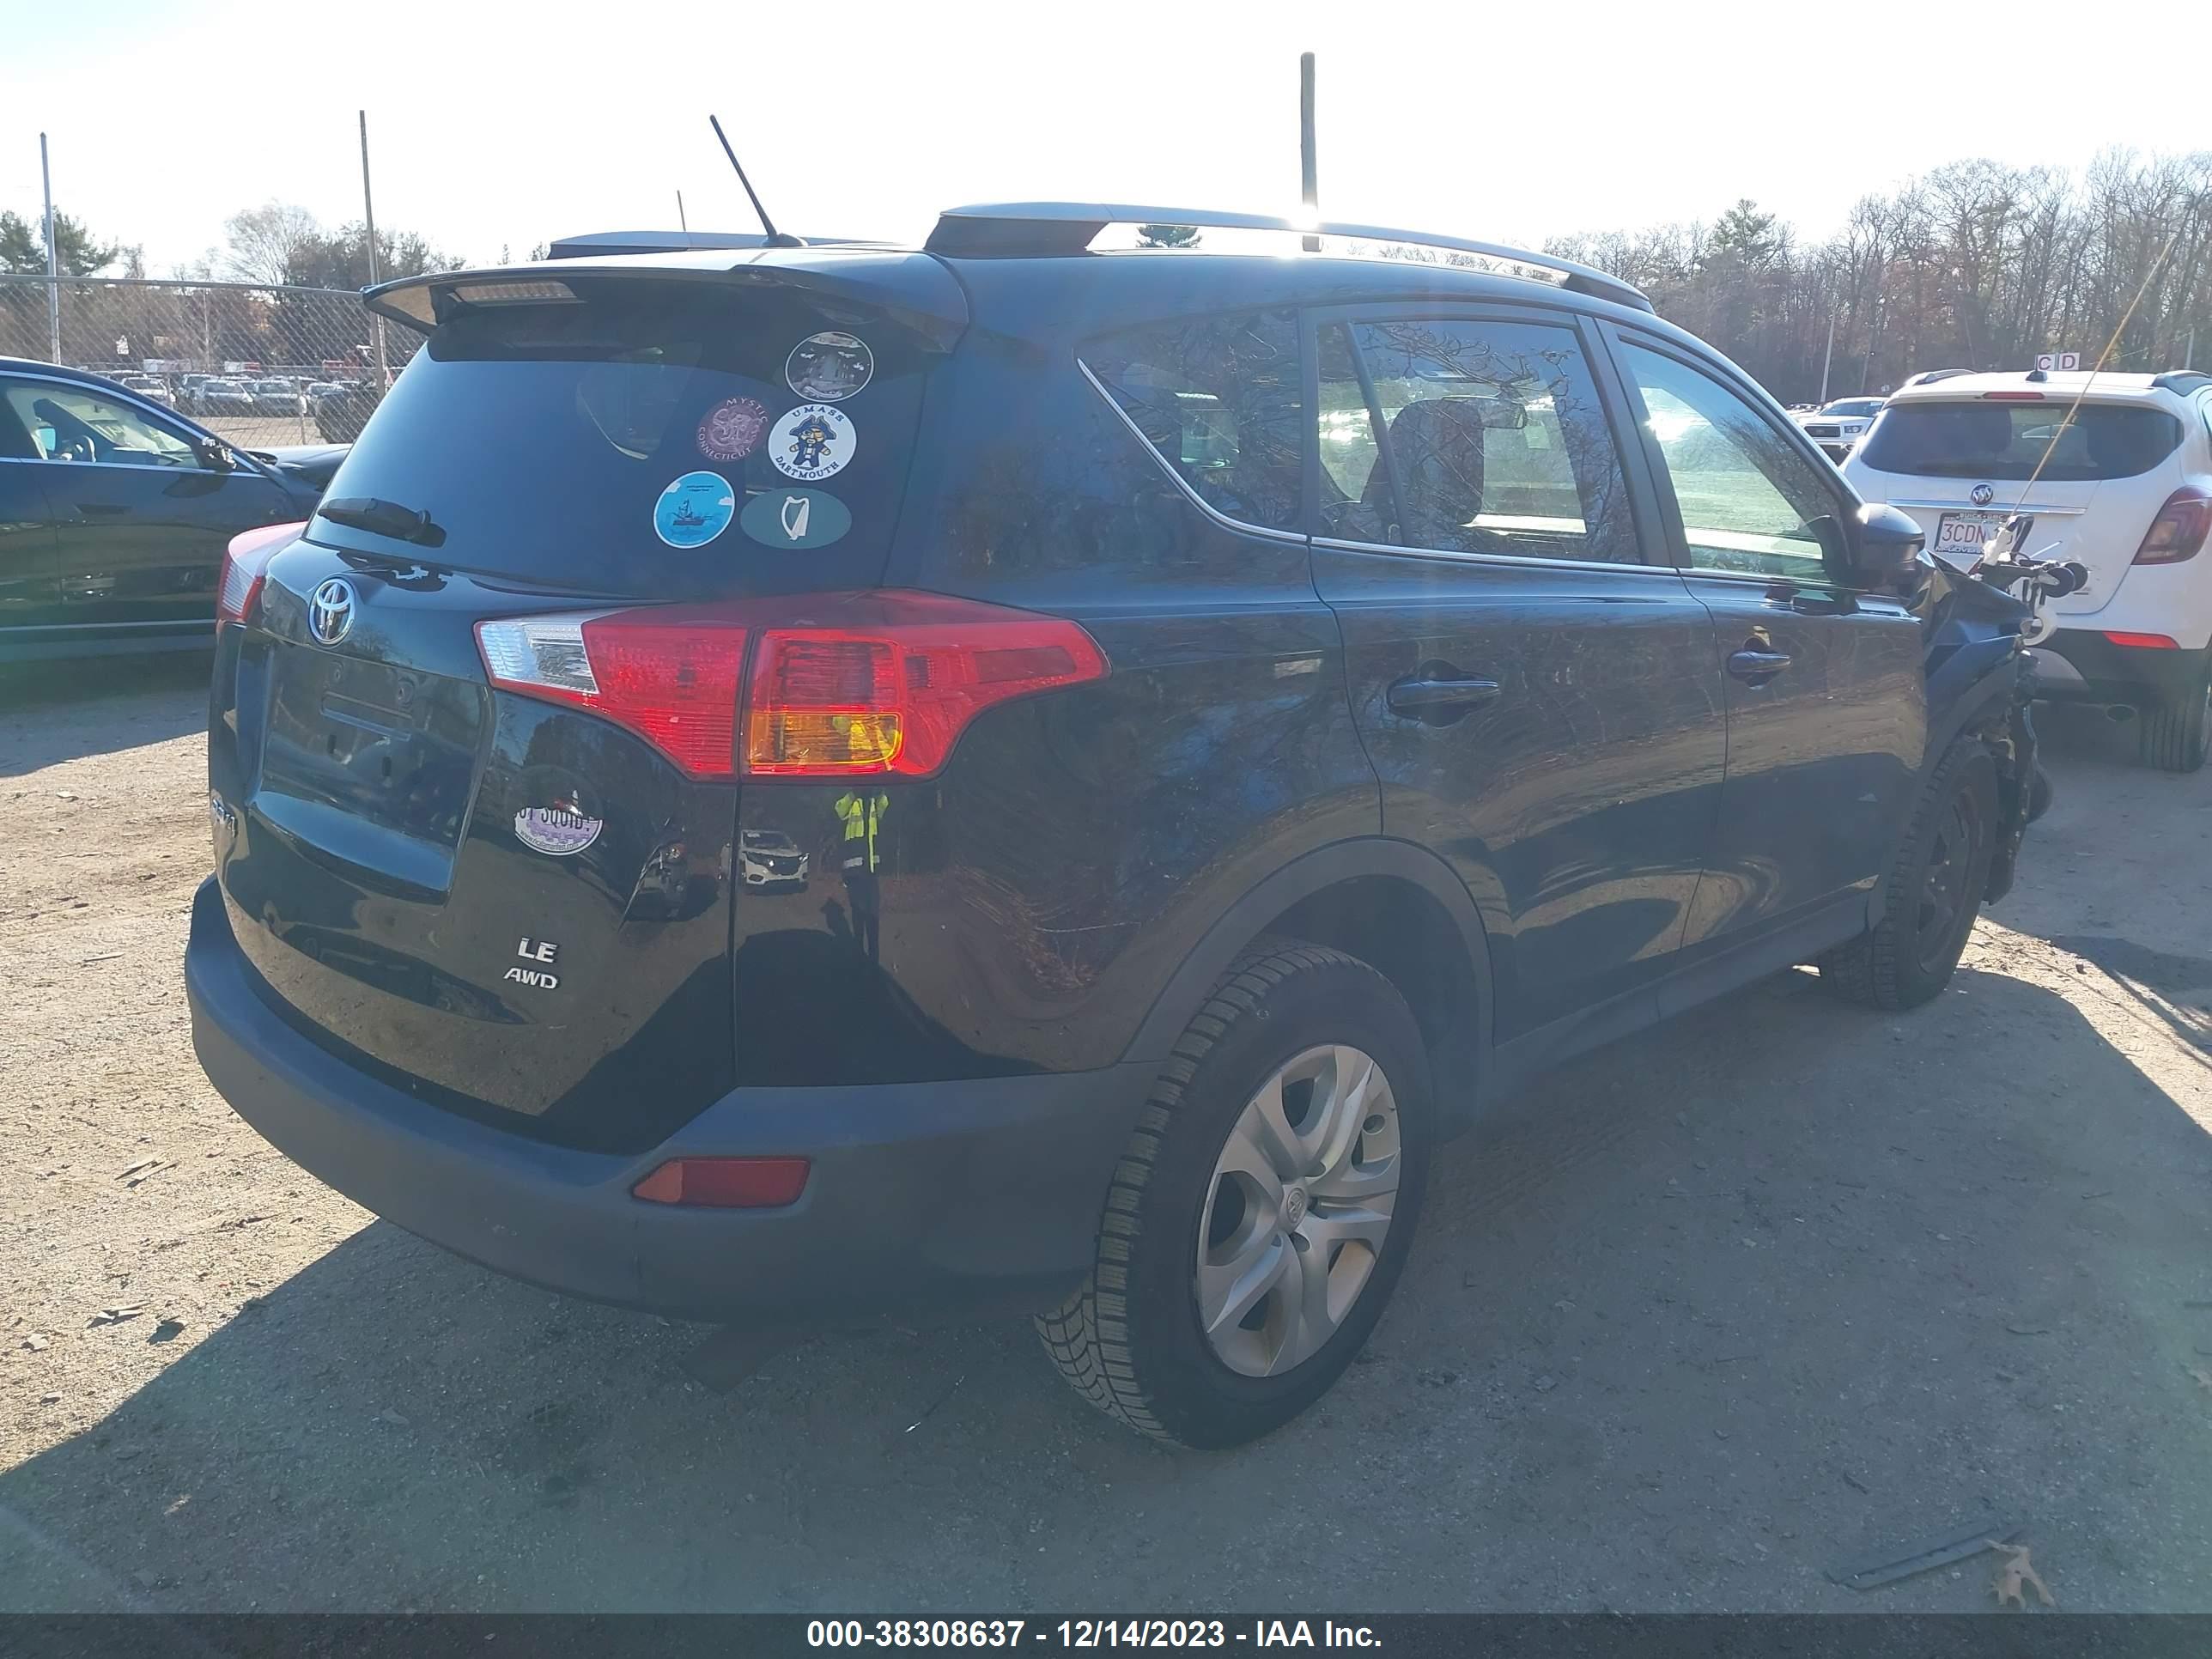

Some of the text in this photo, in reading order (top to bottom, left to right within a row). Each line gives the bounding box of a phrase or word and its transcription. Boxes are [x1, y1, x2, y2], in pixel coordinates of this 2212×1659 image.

[2038, 356, 2051, 370] C
[2062, 355, 2076, 369] D
[726, 398, 769, 423] MYSTIC
[792, 405, 845, 422] UMASS
[698, 426, 751, 460] CONNECTICUT
[775, 455, 840, 478] DARTMOUTH
[1942, 523, 1985, 544] 3CDN
[517, 937, 557, 963] LE
[502, 967, 559, 989] AWD
